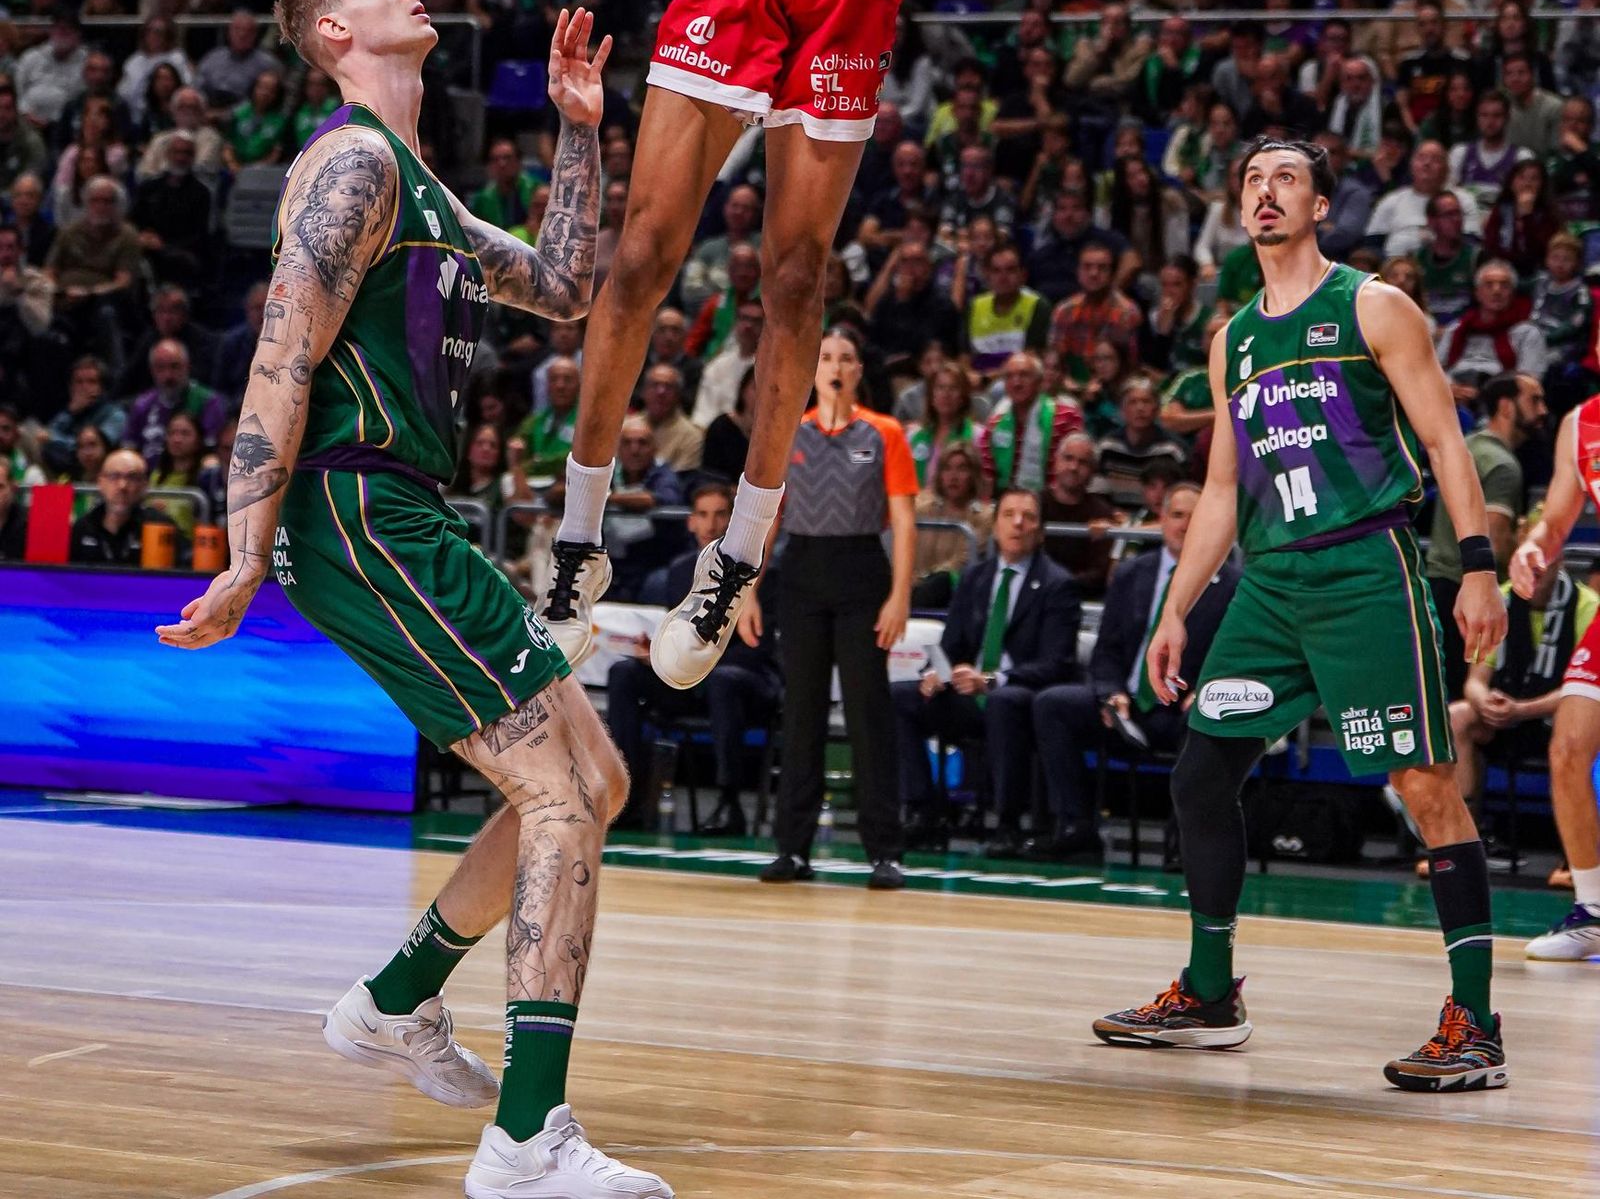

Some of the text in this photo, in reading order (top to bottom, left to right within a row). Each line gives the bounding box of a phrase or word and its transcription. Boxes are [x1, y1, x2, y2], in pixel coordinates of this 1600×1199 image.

[659, 44, 731, 77] unilabor
[811, 73, 843, 93] ETL
[814, 94, 869, 112] GLOBAL
[1263, 376, 1338, 407] Unicaja
[1251, 423, 1327, 459] málaga
[1274, 465, 1317, 523] 14
[1201, 681, 1270, 706] famadesa
[1340, 707, 1369, 720] sabor
[1349, 710, 1384, 734] má
[526, 731, 549, 749] VENI
[1343, 731, 1387, 755] laga
